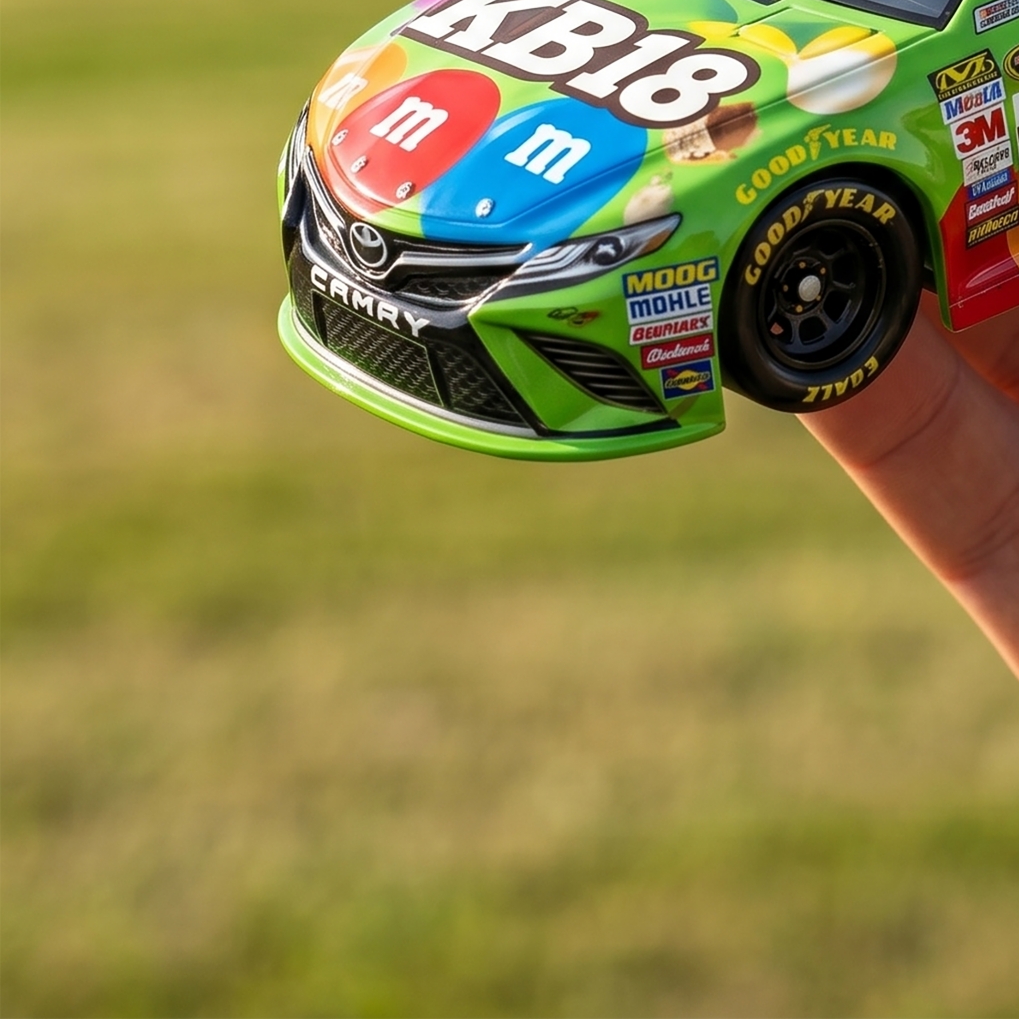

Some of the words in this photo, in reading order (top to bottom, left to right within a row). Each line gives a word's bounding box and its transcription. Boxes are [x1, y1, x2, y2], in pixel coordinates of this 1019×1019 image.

[369, 96, 449, 152] m
[504, 123, 592, 184] m
[955, 107, 1007, 154] 3M
[735, 124, 898, 205] GOODYEAR
[744, 187, 896, 286] GOODYEAR
[310, 264, 431, 338] CAMRY
[627, 259, 717, 295] MOOG
